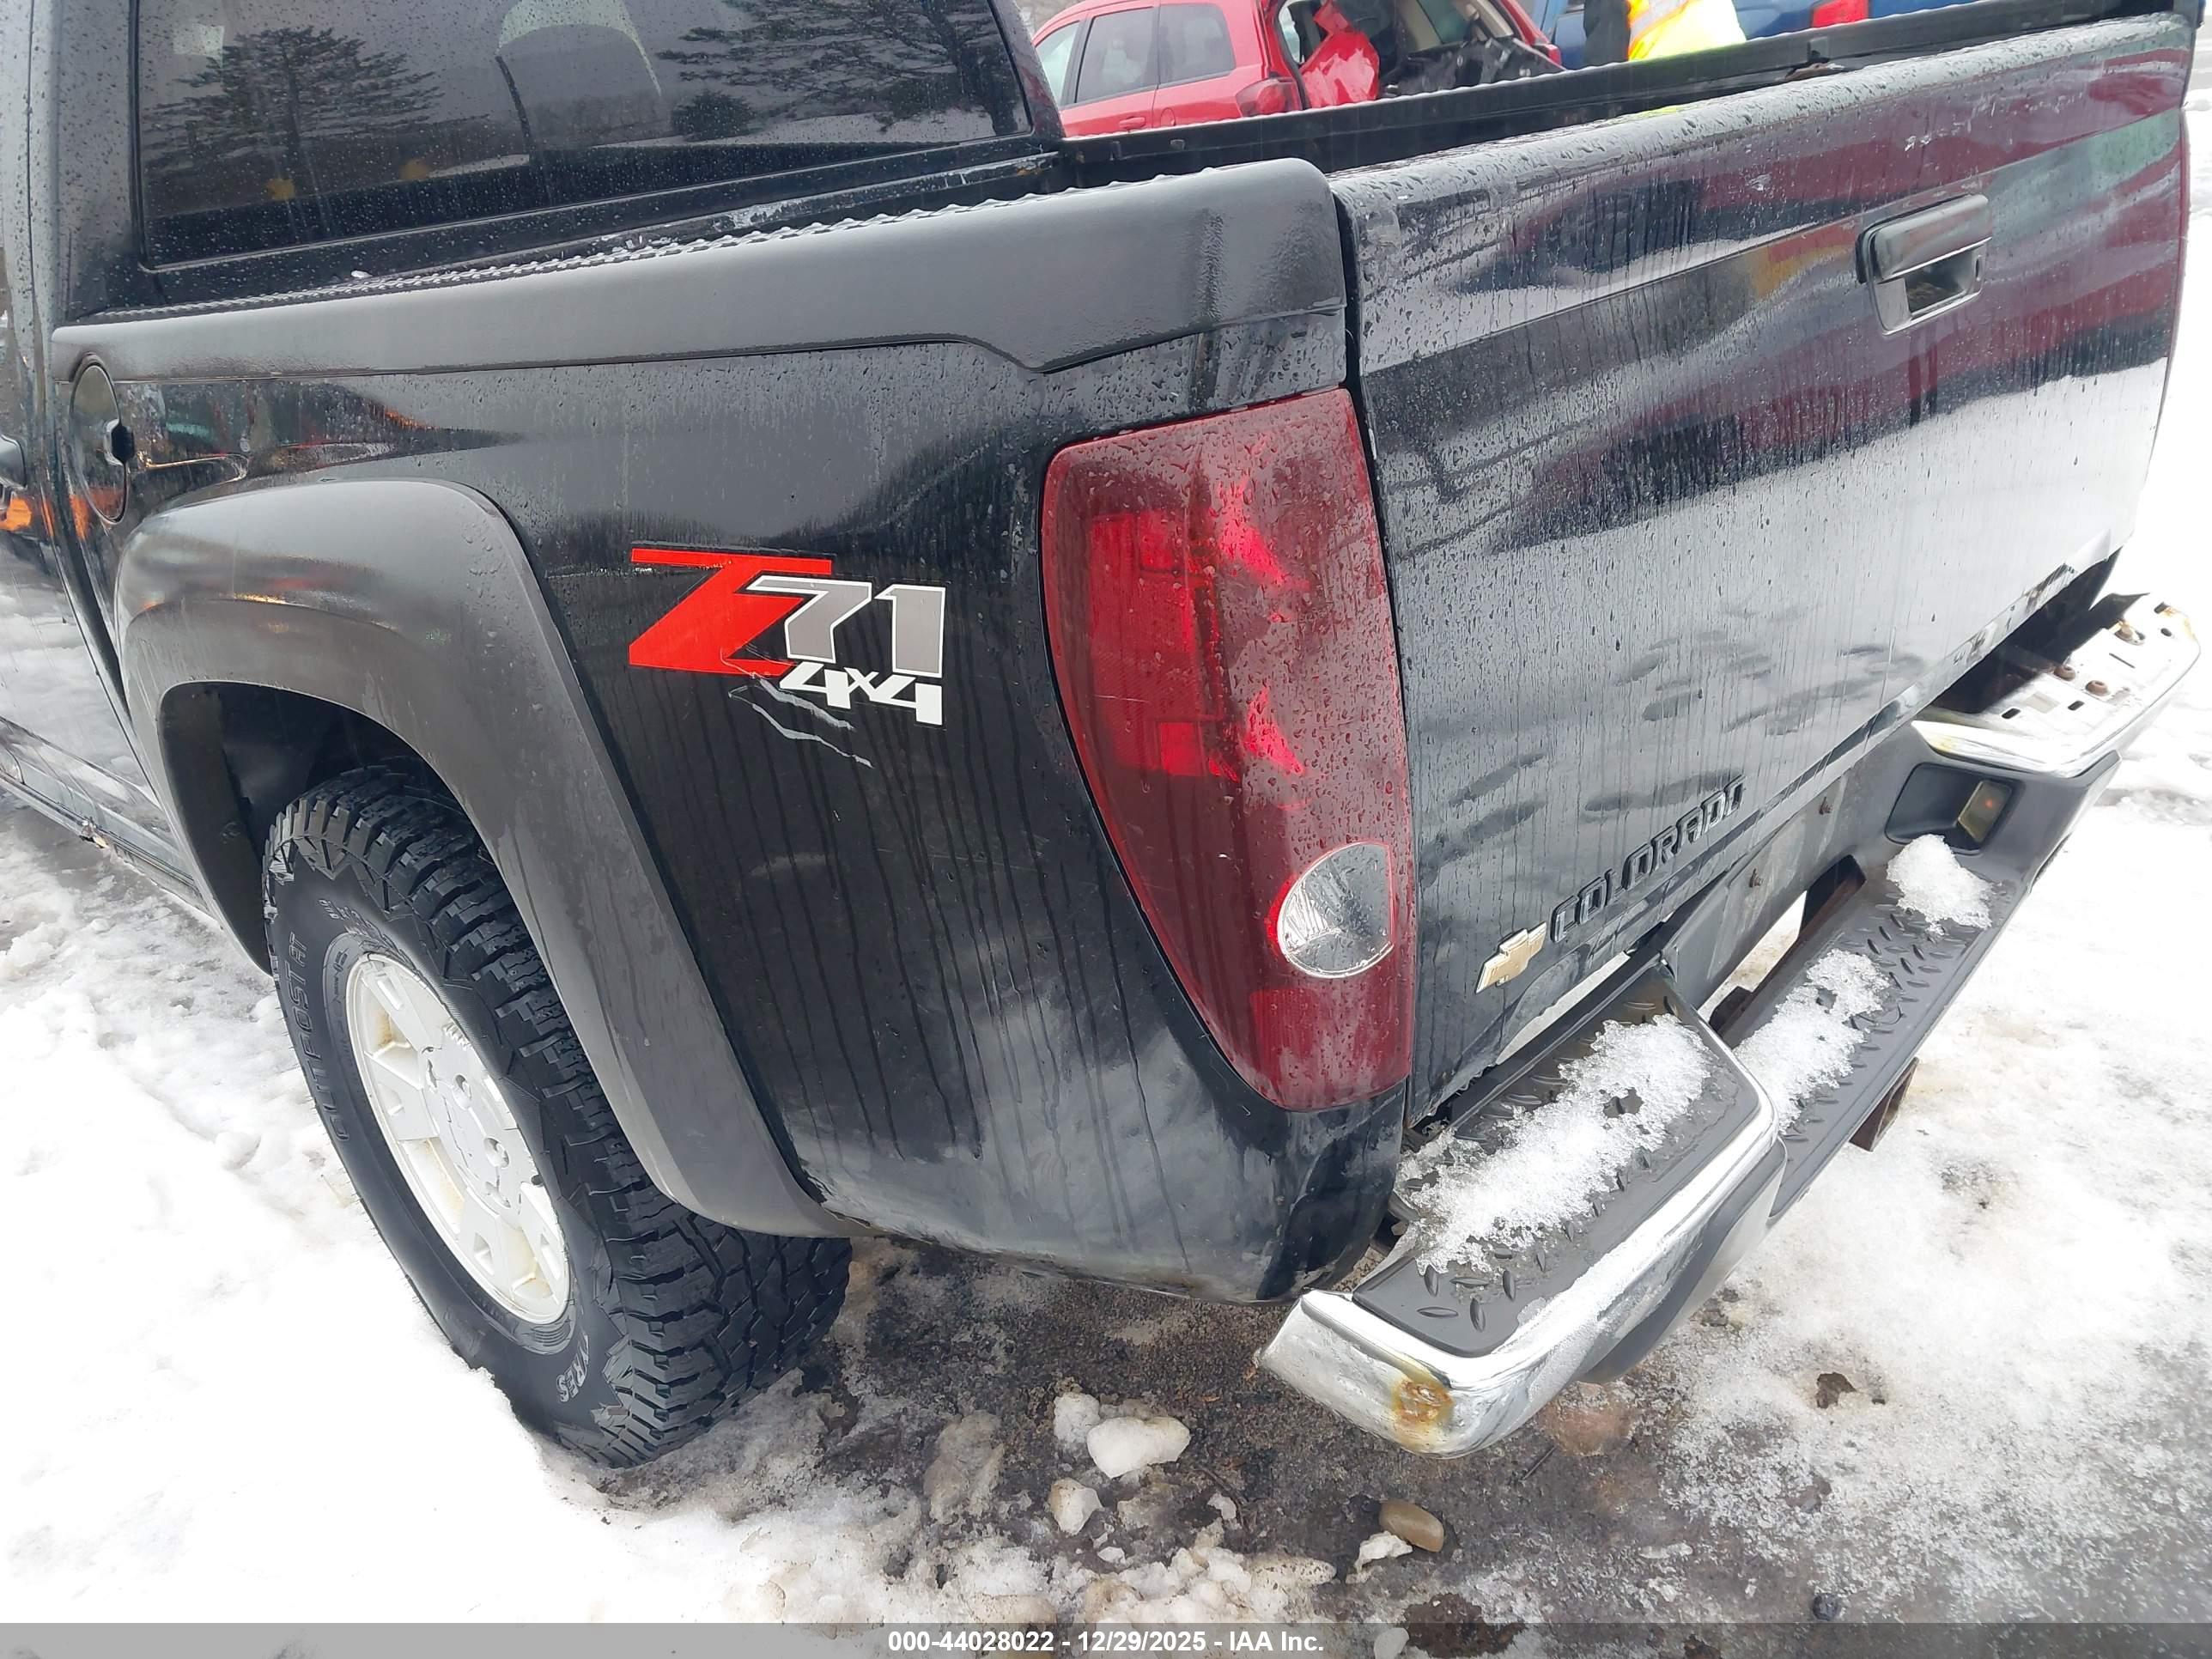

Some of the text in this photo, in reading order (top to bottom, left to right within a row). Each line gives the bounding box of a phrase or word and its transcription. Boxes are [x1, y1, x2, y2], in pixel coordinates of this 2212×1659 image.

[629, 547, 946, 678] Z71
[1549, 775, 1747, 943] COLORADO
[288, 931, 307, 969] AT
[284, 959, 349, 1141] OUTPOST
